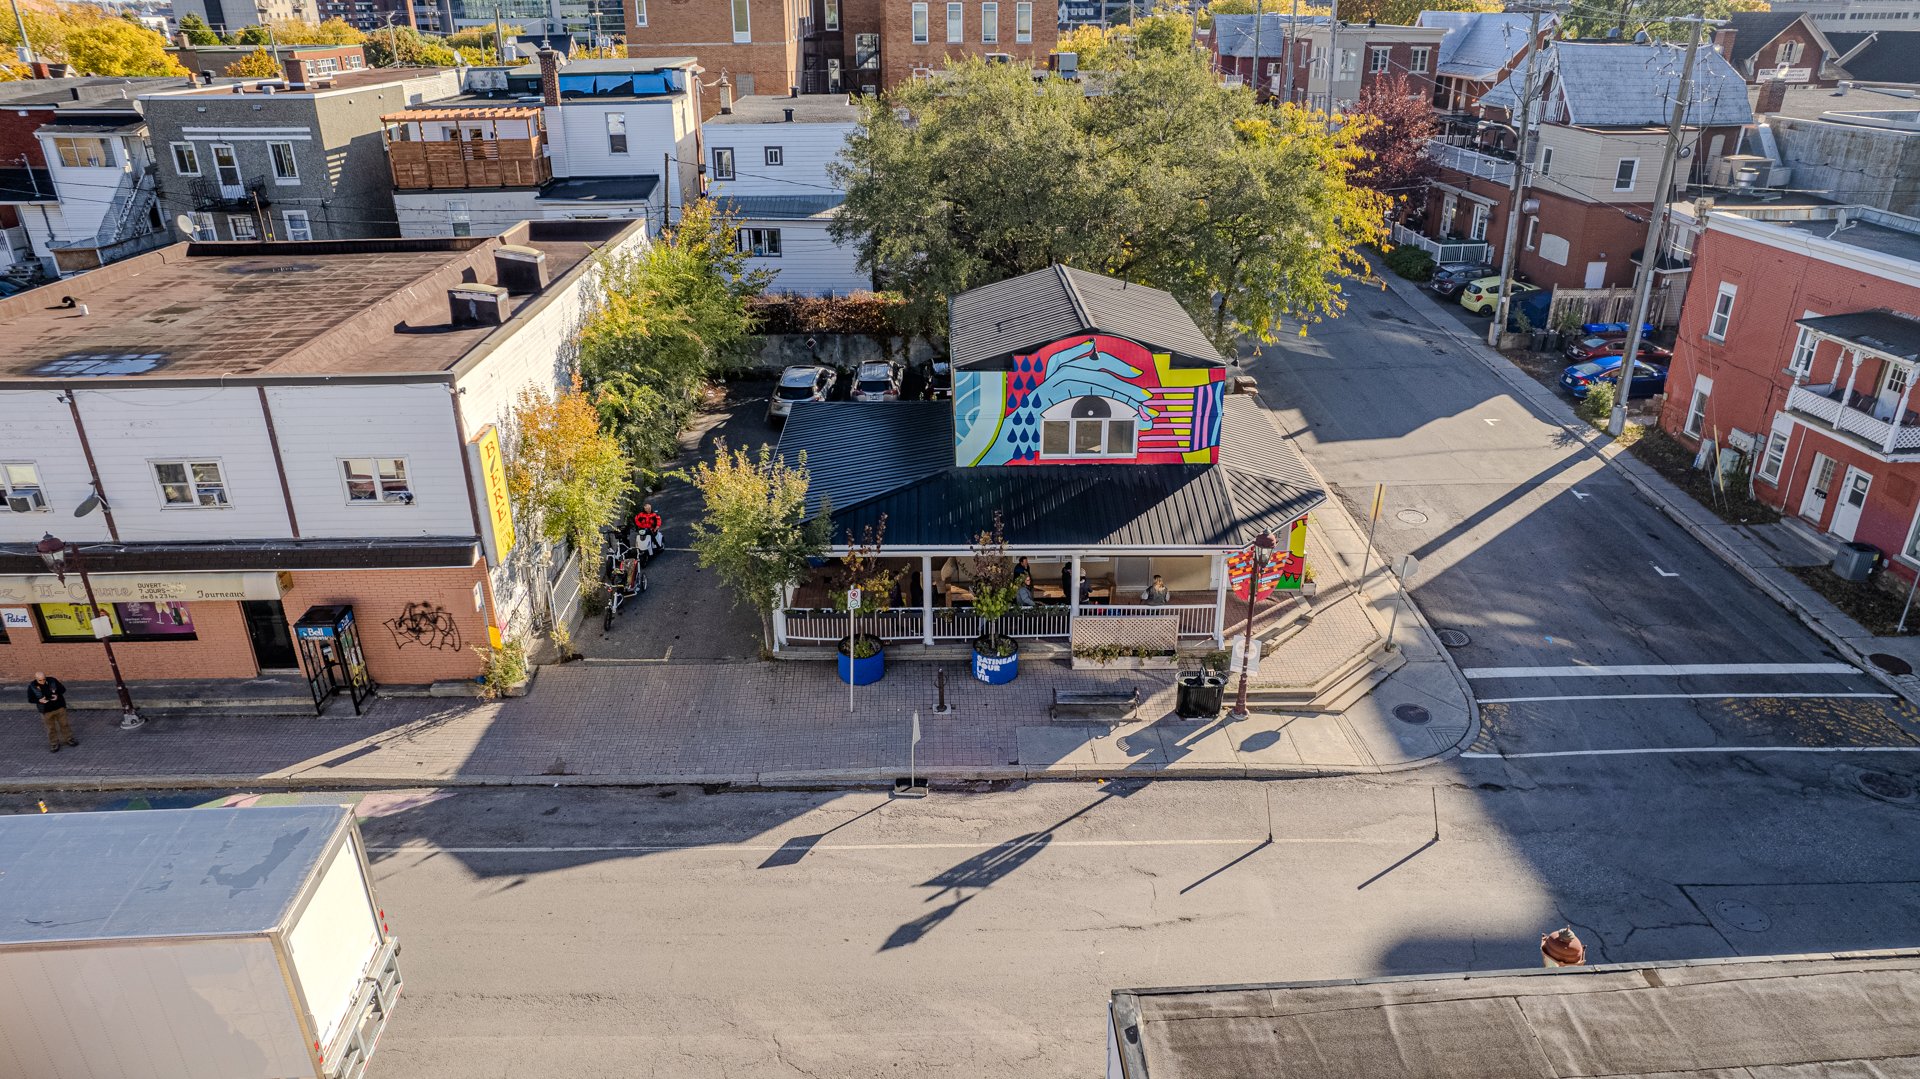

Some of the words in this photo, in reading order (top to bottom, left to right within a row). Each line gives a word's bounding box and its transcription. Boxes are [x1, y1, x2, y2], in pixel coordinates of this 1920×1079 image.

[4, 613, 28, 623] Pabst
[308, 628, 324, 636] Bell
[977, 653, 1017, 665] GATINEAU
[976, 660, 1001, 672] POUR
[976, 666, 986, 676] LA
[977, 672, 990, 683] VIE
